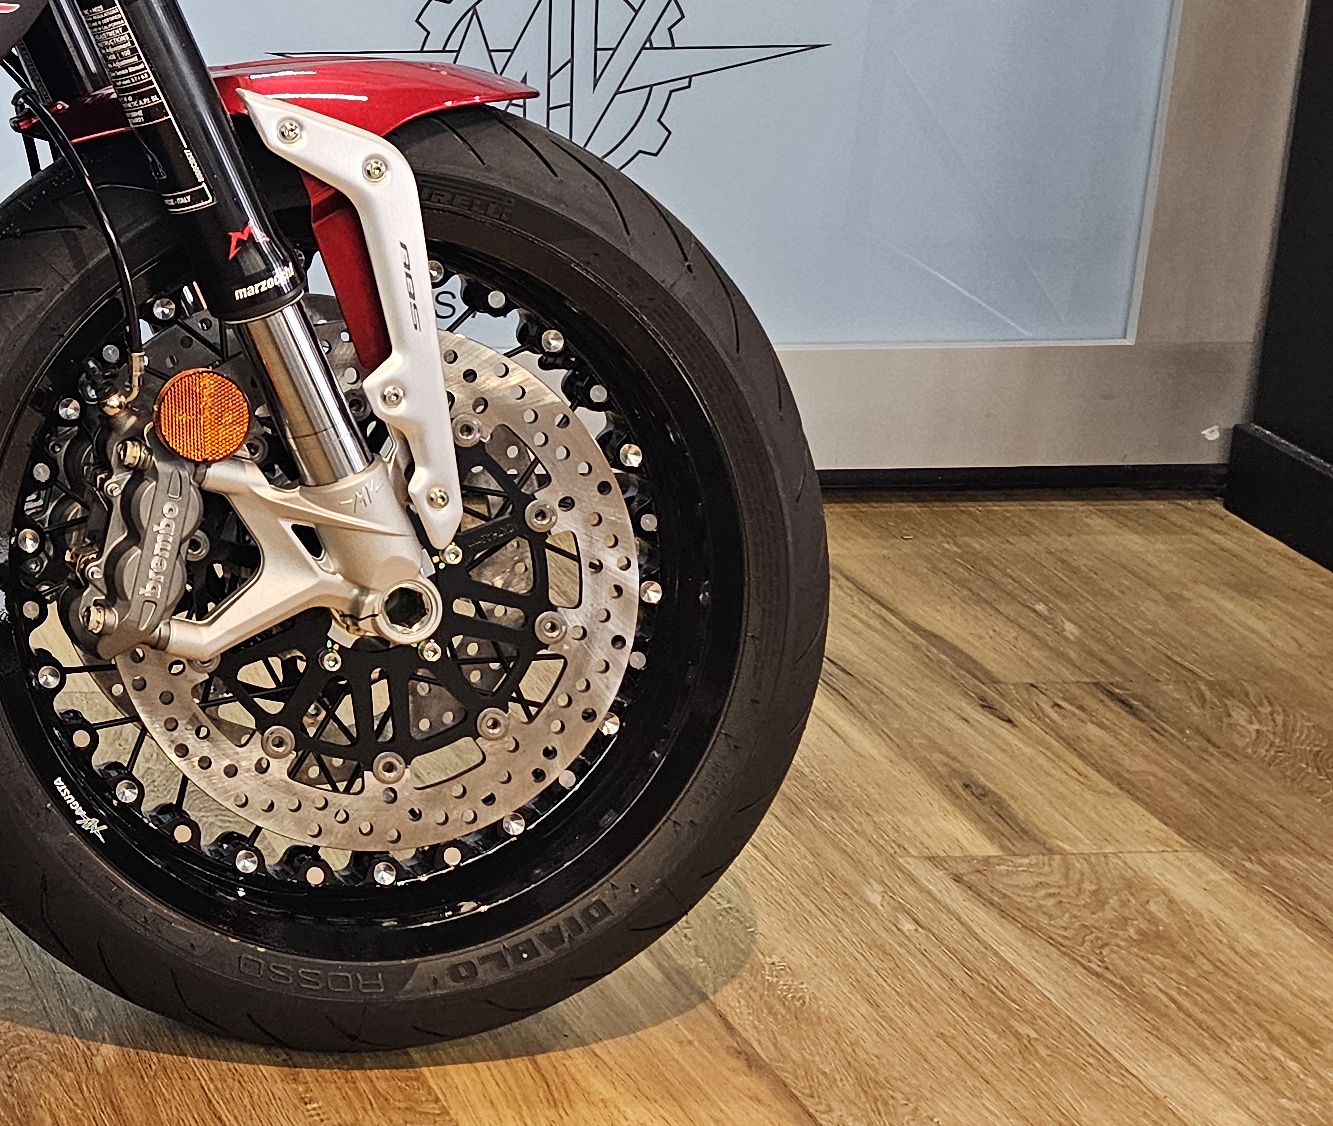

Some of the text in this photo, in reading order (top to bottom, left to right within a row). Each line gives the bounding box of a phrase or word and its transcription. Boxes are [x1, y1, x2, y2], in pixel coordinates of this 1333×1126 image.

[138, 500, 179, 600] brembo
[53, 776, 87, 816] AGUSTA
[238, 898, 616, 993] DIABLO ROSSO
